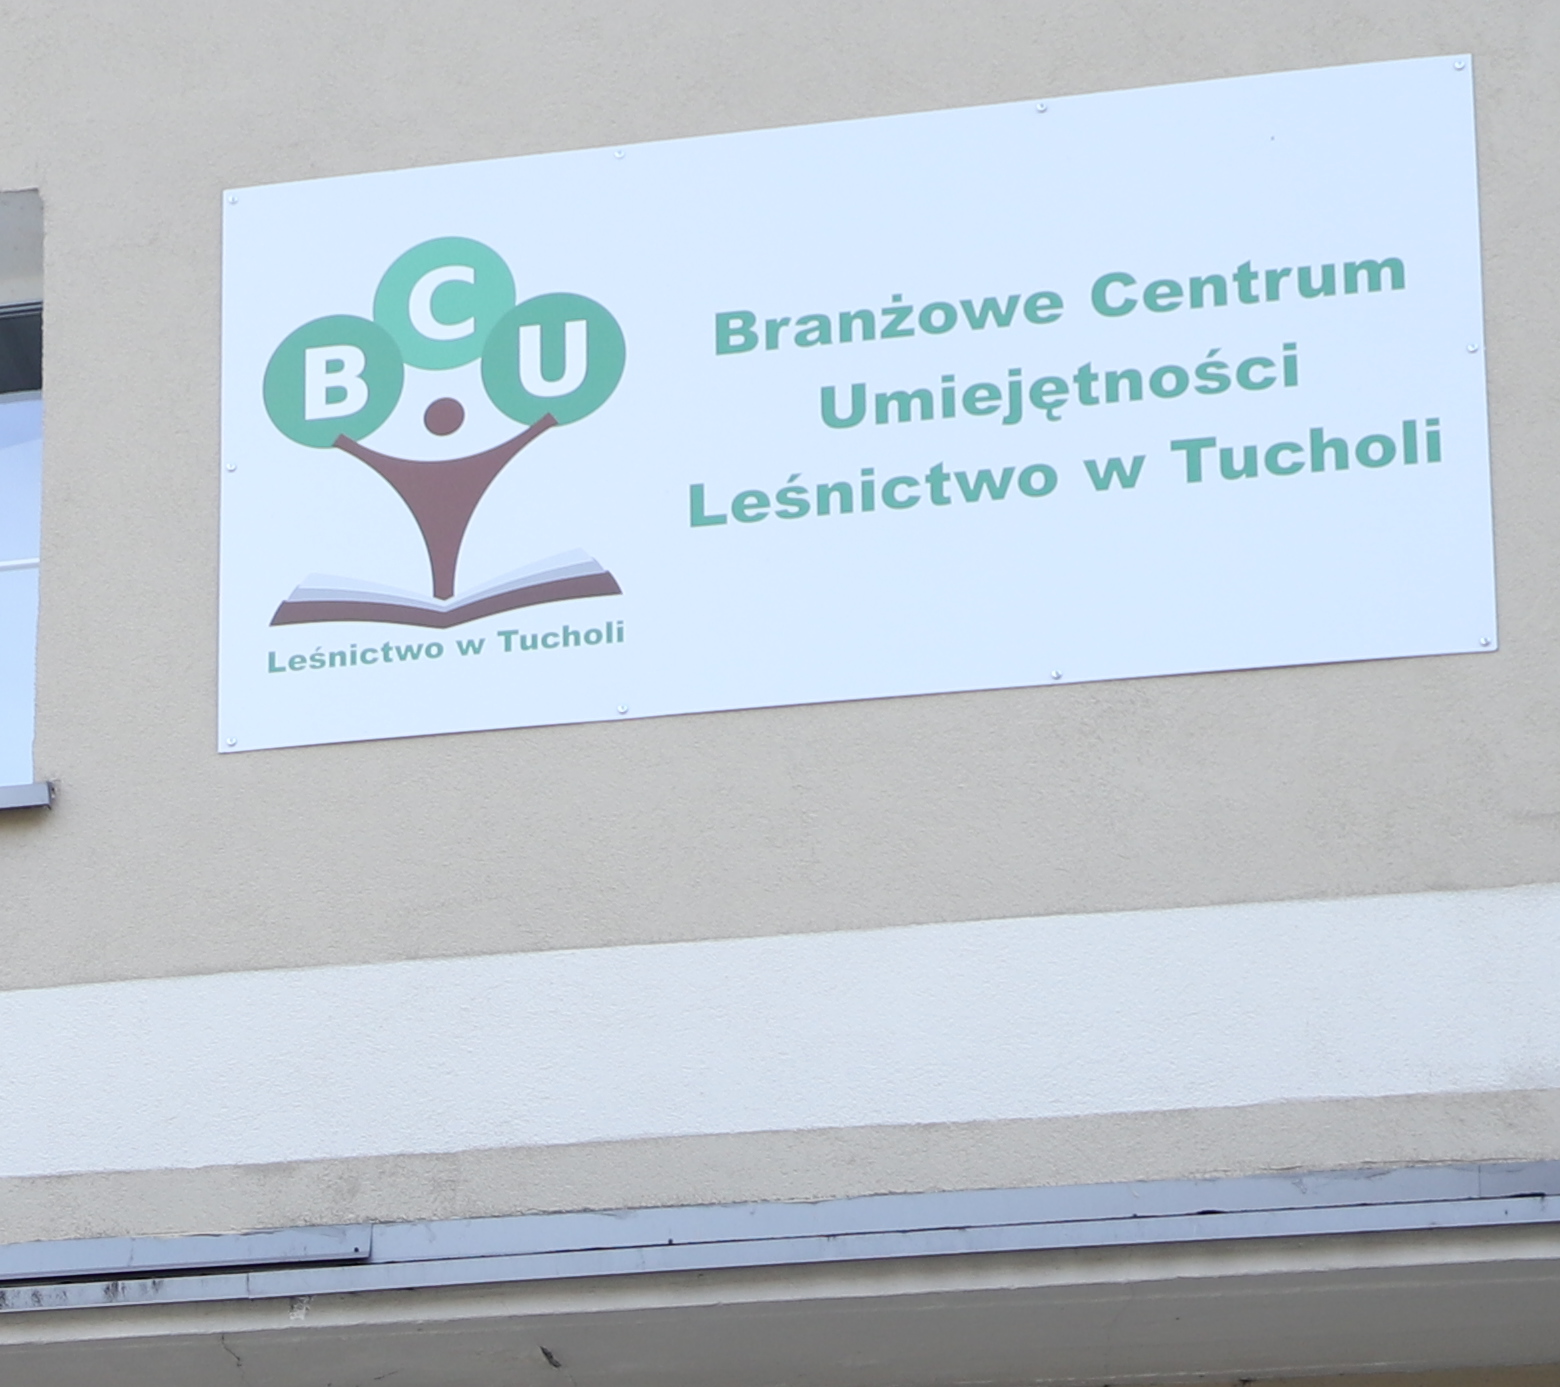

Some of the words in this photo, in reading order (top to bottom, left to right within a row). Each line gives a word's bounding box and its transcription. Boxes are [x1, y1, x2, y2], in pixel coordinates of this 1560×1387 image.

[715, 291, 1063, 355] Branżowe
[1091, 257, 1405, 317] Centrum
[821, 342, 1298, 429] Umiejętności
[690, 462, 1058, 527] Leśnictwo
[1083, 455, 1146, 491] w
[1170, 417, 1441, 483] Tucholi
[268, 642, 443, 673] Leśnictwo
[456, 638, 485, 656] w
[497, 621, 623, 652] Tucholi
